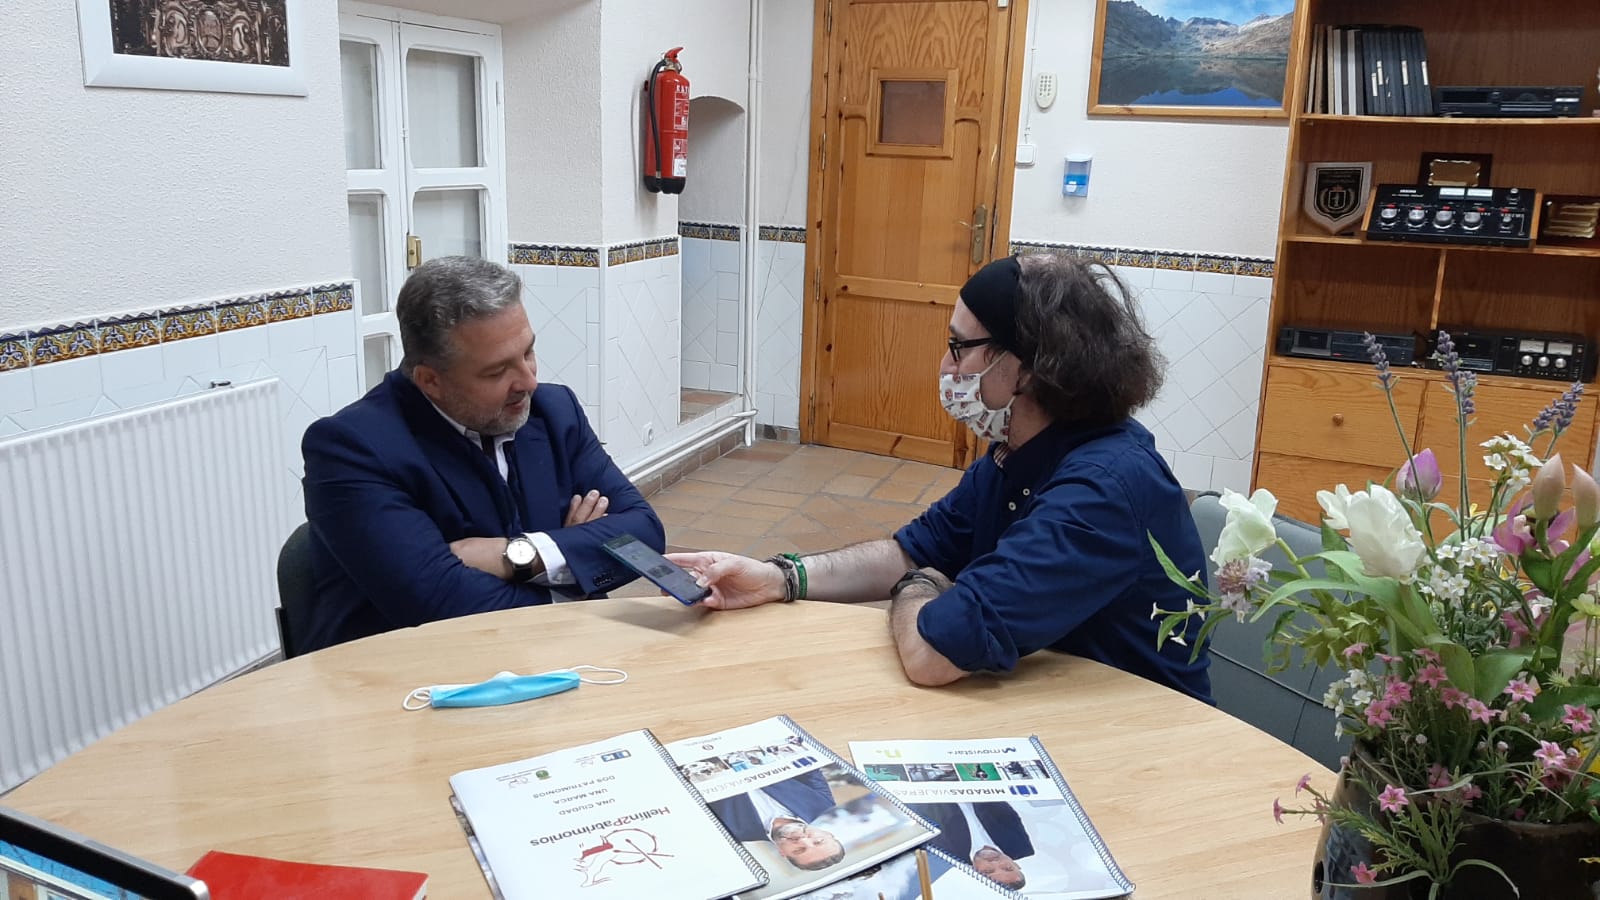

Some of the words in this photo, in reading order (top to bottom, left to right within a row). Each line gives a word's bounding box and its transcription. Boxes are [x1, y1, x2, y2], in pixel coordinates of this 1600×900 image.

[533, 780, 594, 799] PATRIMONIOS
[588, 788, 608, 797] UNA
[552, 794, 587, 805] MARCA
[595, 798, 616, 807] UNA
[558, 803, 594, 816] CIUDAD
